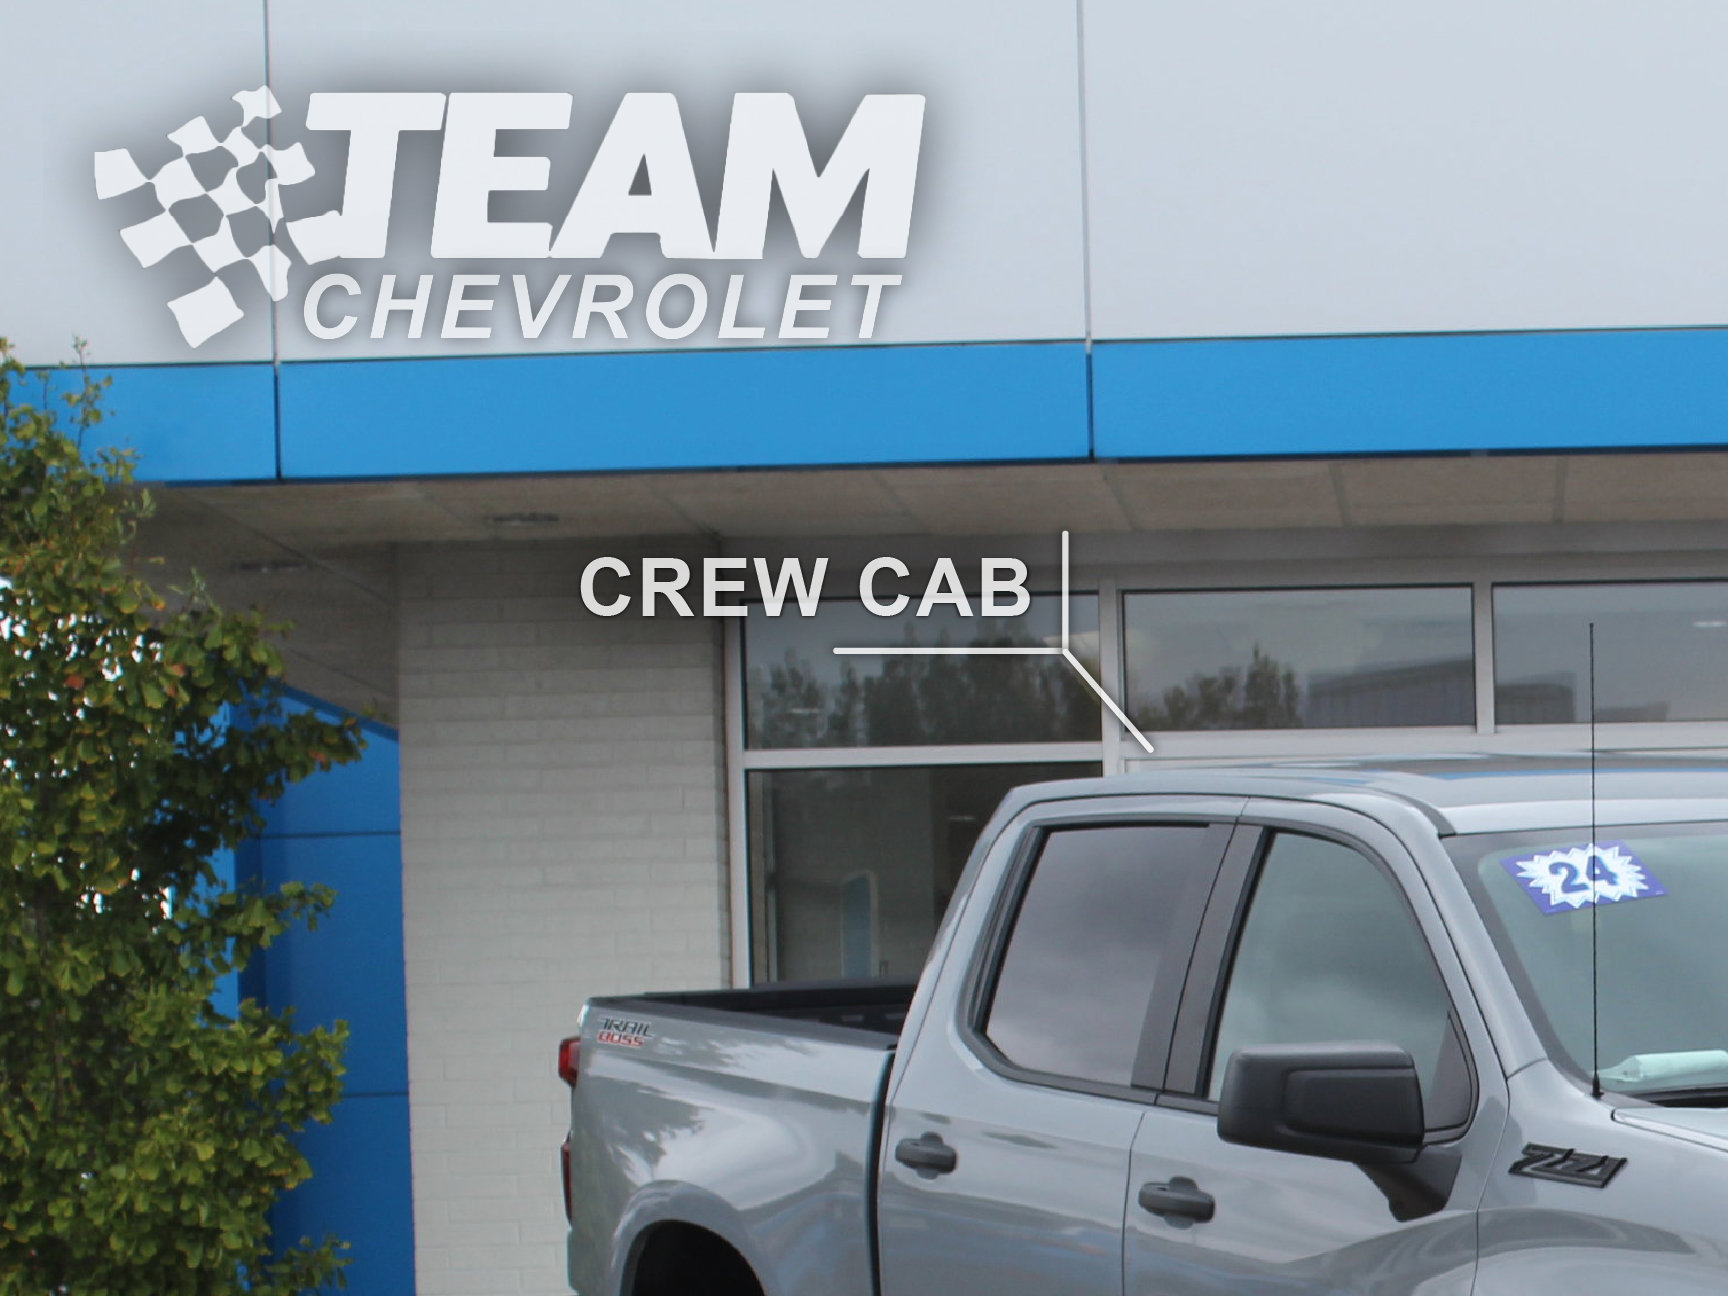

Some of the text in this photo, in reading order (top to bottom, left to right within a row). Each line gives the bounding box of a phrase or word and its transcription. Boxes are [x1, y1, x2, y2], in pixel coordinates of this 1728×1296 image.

[1548, 855, 1619, 893] 24
[600, 1017, 655, 1038] TRAIL
[598, 1030, 645, 1047] BOSS
